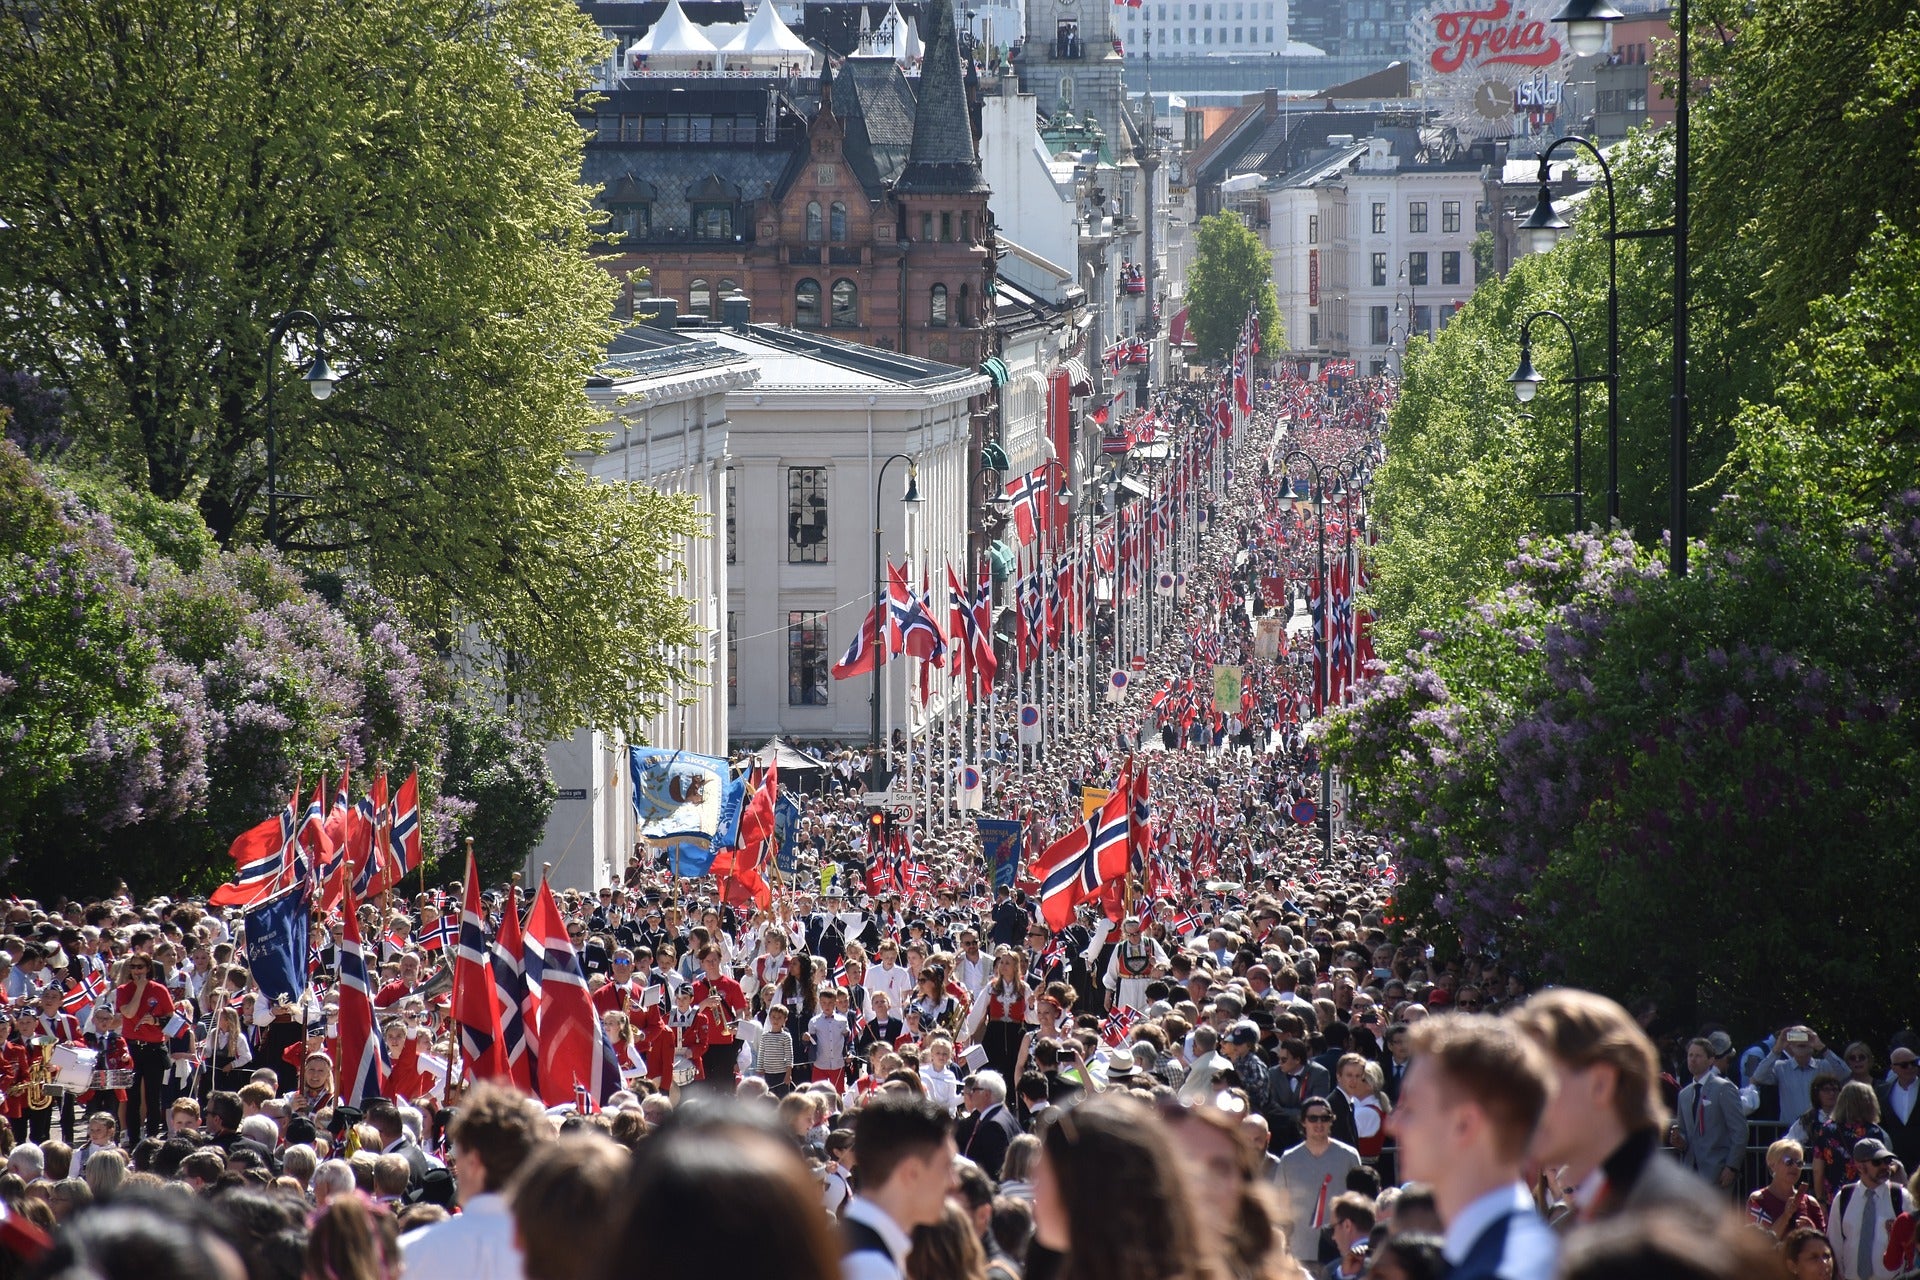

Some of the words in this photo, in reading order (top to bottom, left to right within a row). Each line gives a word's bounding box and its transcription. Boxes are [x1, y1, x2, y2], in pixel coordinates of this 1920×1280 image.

[1431, 0, 1561, 73] Freia
[1517, 74, 1564, 105] isklar
[684, 755, 720, 772] SKOLE
[895, 793, 913, 801] Sone
[897, 808, 910, 818] 30
